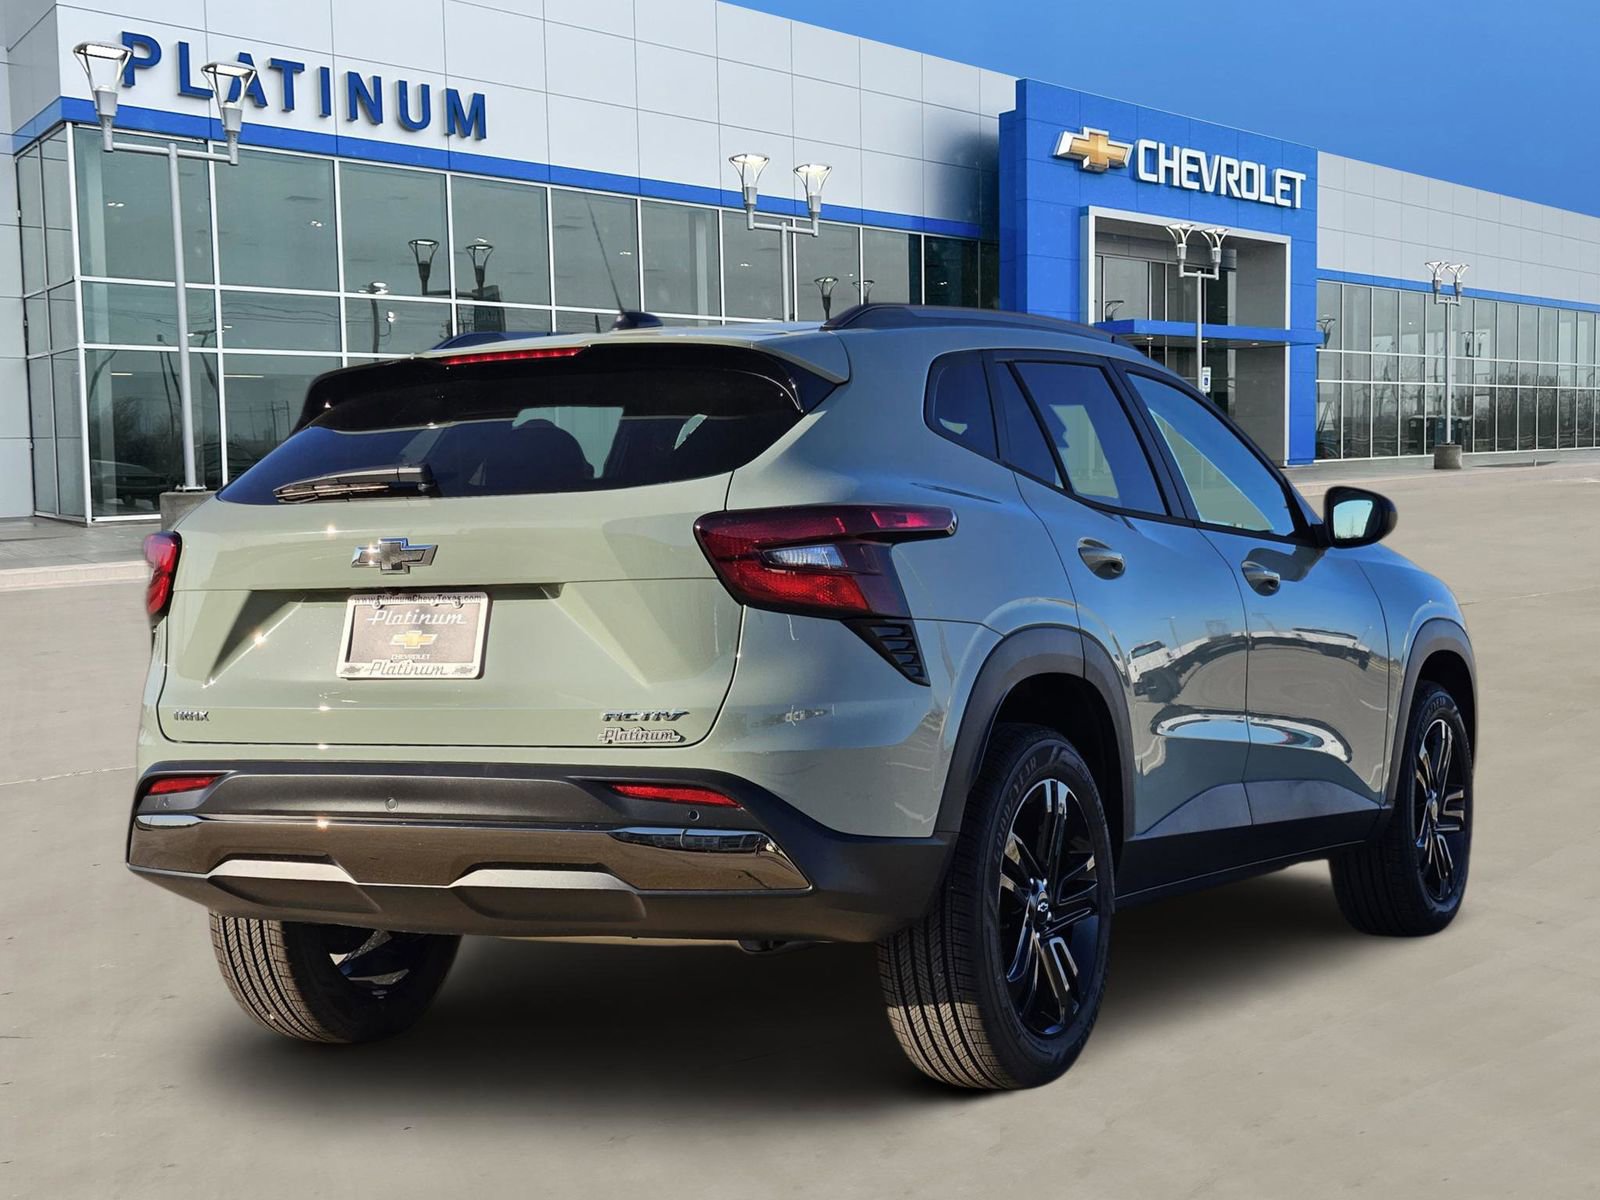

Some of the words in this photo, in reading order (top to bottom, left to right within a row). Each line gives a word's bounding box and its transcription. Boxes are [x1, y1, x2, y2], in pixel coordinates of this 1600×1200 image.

[121, 31, 487, 141] PLATINUM
[1137, 138, 1306, 209] CHEVROLET
[367, 609, 467, 625] Platinum
[364, 660, 448, 676] Platinum
[598, 727, 681, 743] Platinum
